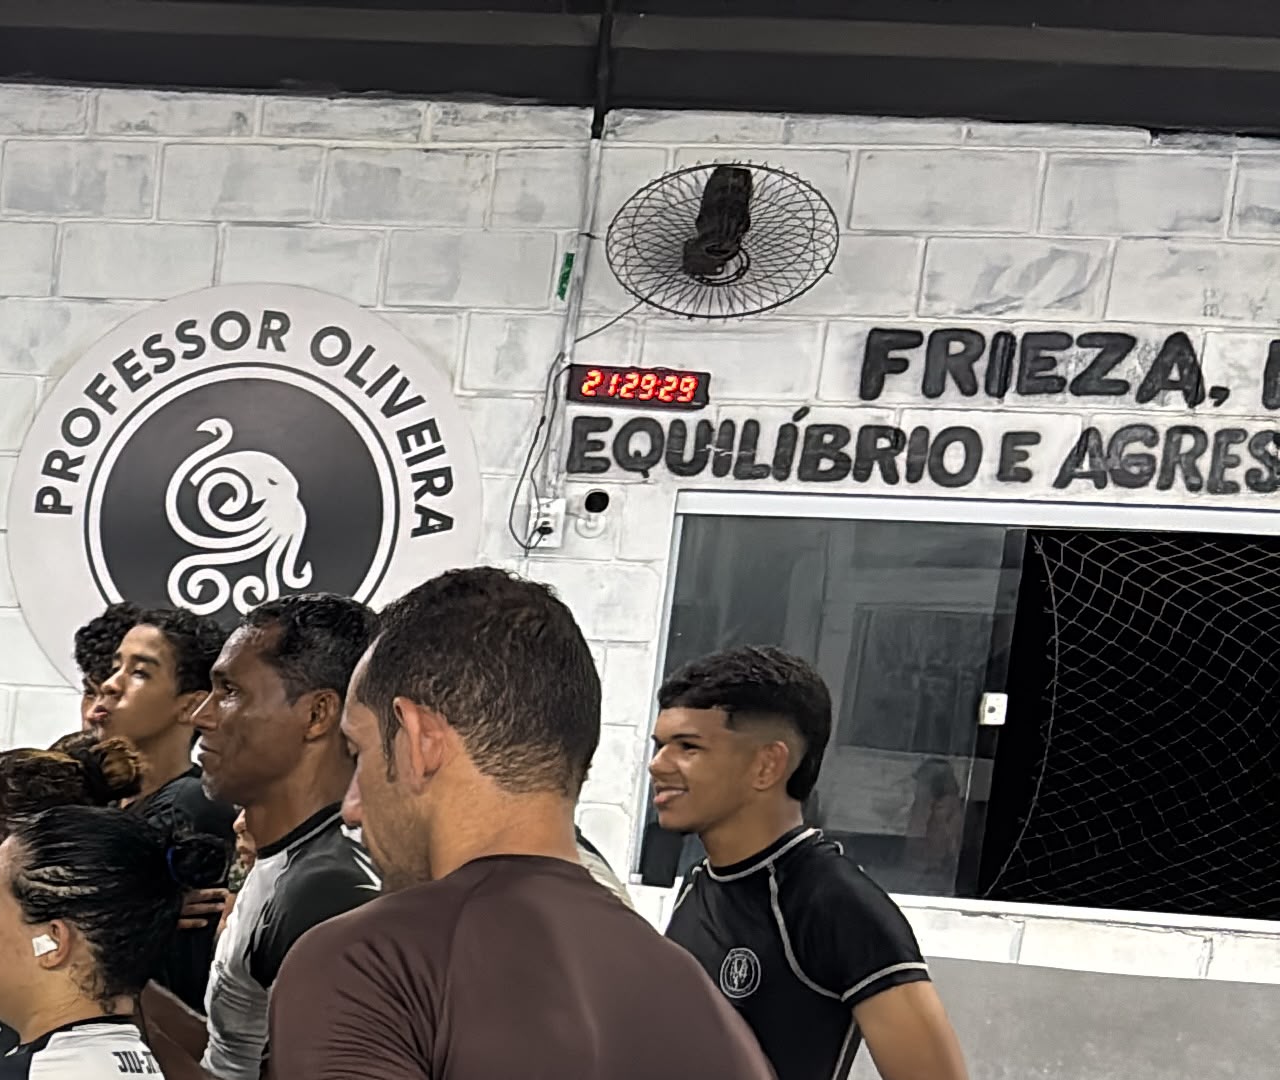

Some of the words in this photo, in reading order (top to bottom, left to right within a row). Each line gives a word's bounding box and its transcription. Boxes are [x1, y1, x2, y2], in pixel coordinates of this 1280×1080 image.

[34, 310, 291, 515] PROFESSOR
[310, 325, 456, 540] OLIVEIRA
[581, 369, 699, 402] 21:29:29
[565, 407, 983, 488] EQUILÍBRIO
[997, 430, 1042, 483] E
